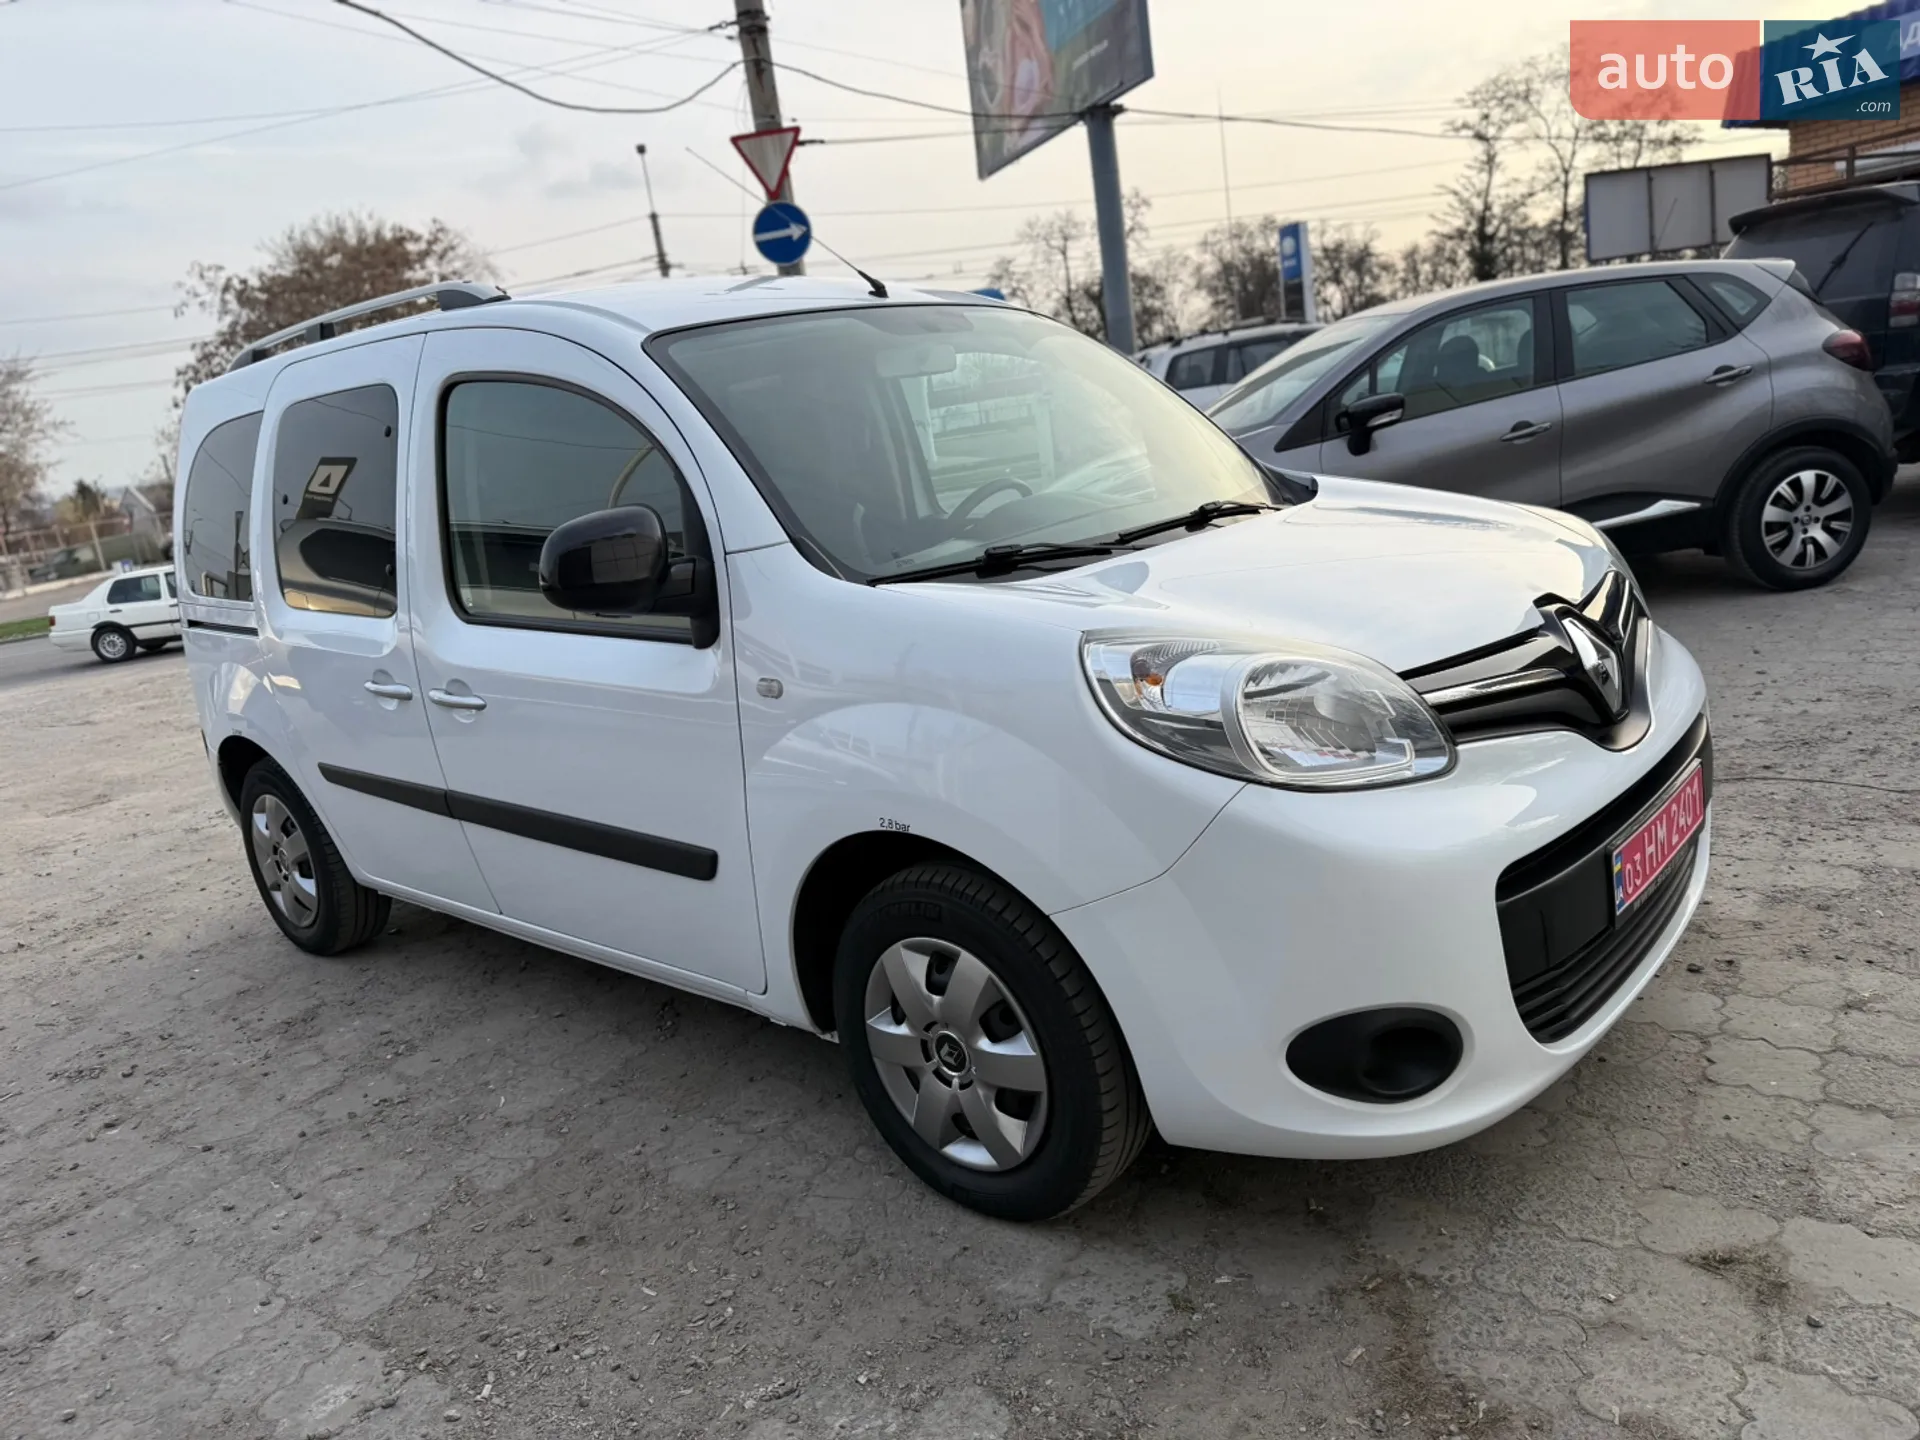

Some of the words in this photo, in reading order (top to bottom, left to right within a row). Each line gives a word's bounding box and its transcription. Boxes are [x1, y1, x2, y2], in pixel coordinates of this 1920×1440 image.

[894, 820, 911, 832] bar
[1625, 852, 1642, 894] 03
[1643, 815, 1667, 874] HM
[1671, 777, 1700, 846] 2401
[1615, 885, 1624, 904] UA
